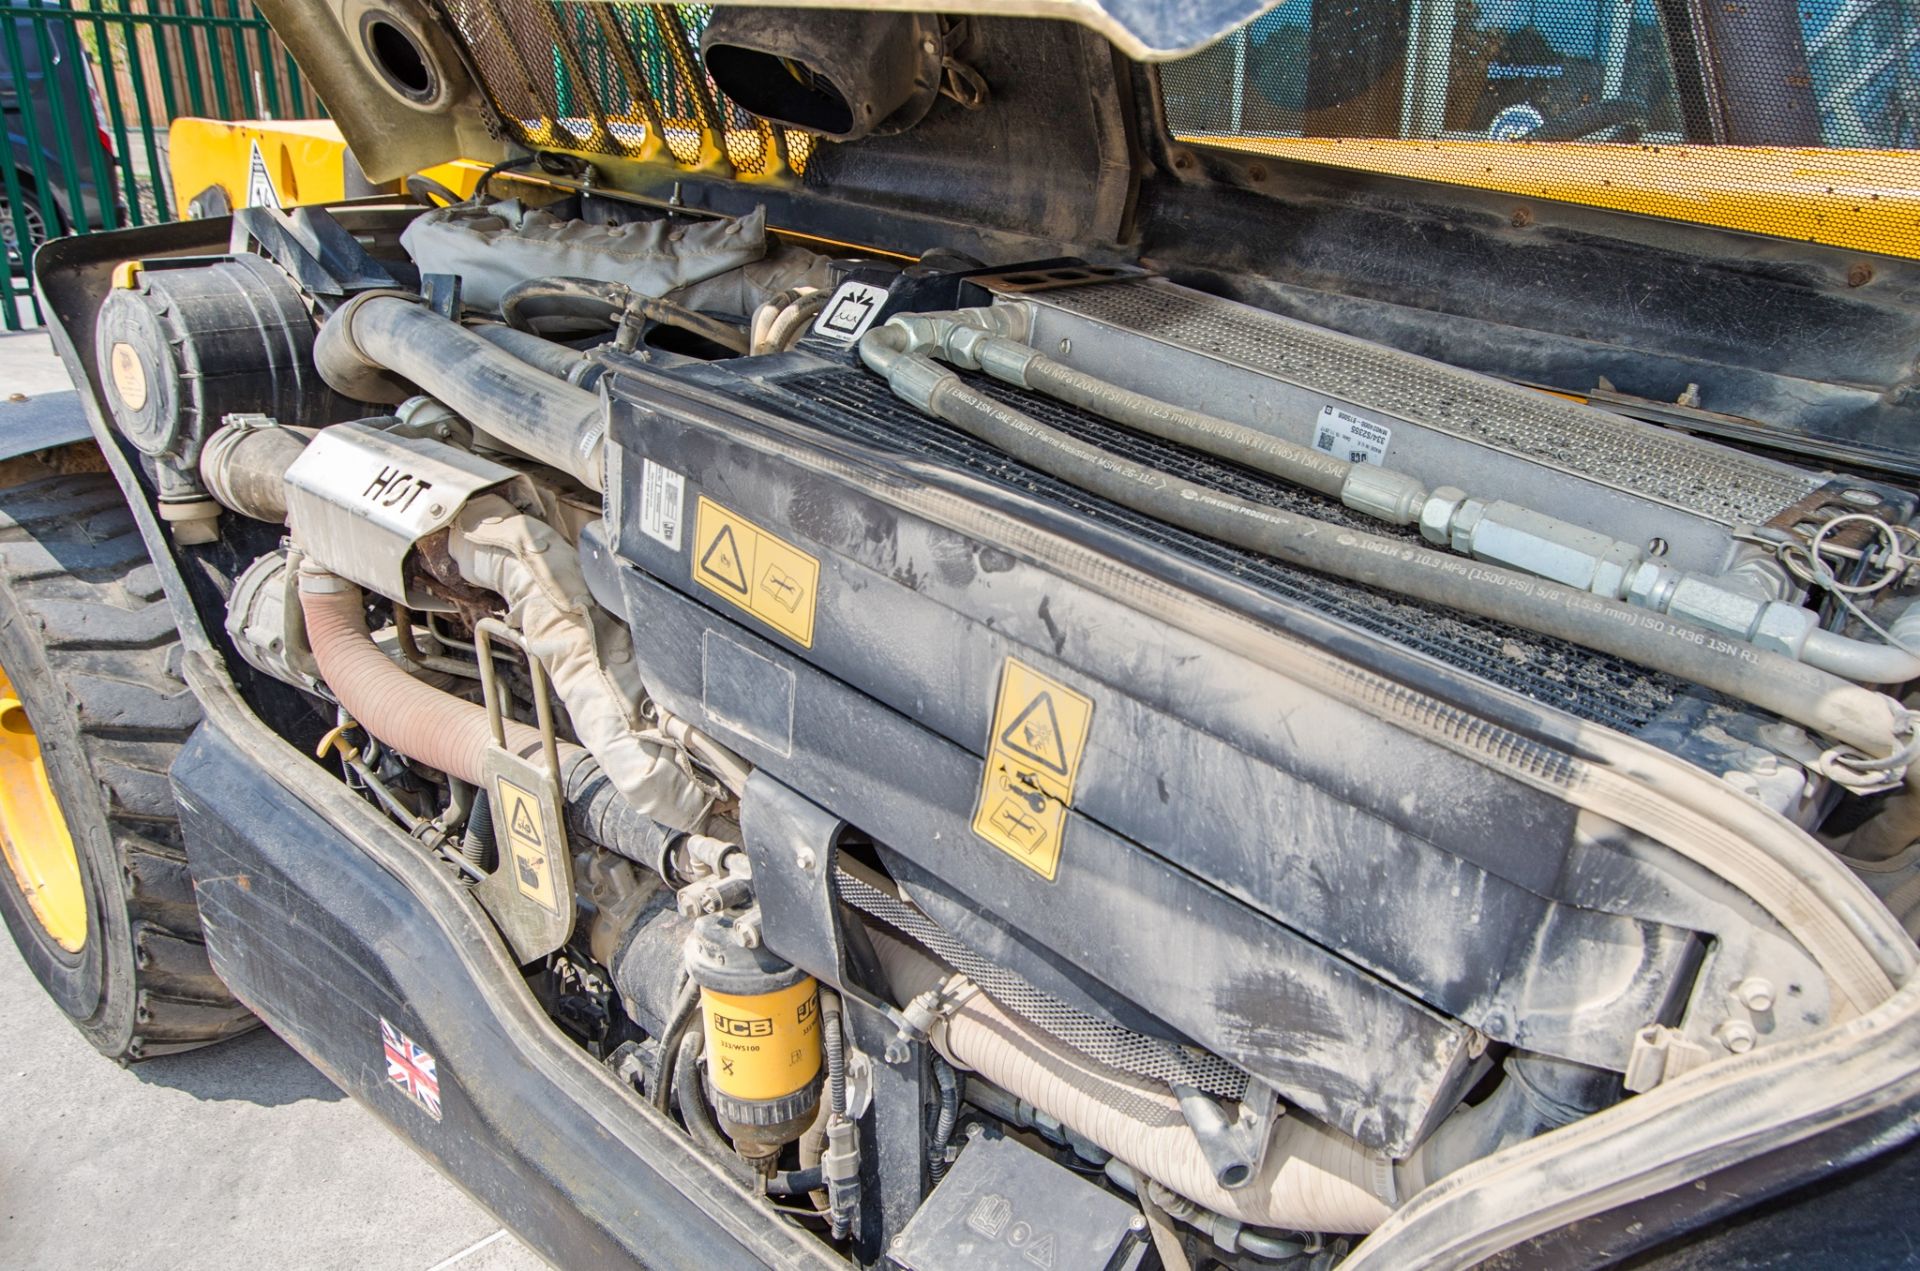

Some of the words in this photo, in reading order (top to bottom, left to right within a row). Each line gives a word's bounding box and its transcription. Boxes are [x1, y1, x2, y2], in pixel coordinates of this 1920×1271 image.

[995, 409, 1012, 427] SAE
[1035, 426, 1060, 446] Flame
[1059, 439, 1099, 464] Resistant
[1051, 367, 1073, 383] MPa
[1325, 461, 1346, 479] SAE
[1350, 451, 1368, 464] JCB
[363, 466, 432, 513] HOT
[1441, 560, 1468, 576] MPa
[1640, 617, 1664, 632] ISO
[1667, 625, 1705, 646] 1436
[1740, 649, 1760, 665] R1
[714, 1012, 774, 1037] JCB
